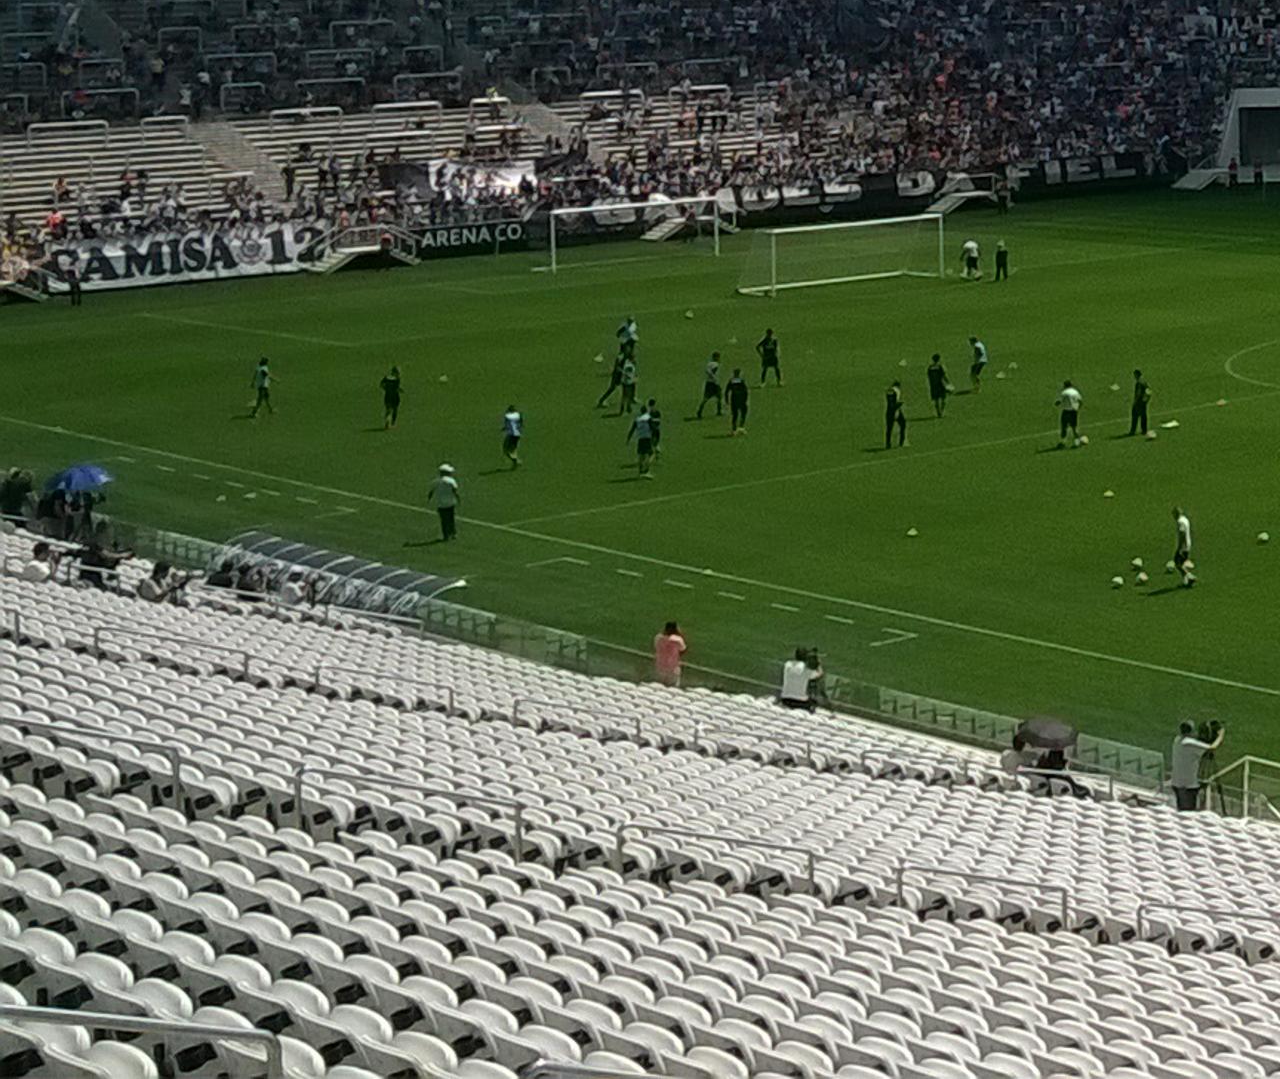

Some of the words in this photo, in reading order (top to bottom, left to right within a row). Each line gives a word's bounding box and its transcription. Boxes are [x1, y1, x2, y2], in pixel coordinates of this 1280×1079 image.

[46, 233, 238, 283] CAMISA
[264, 226, 327, 265] 12
[421, 226, 491, 248] ARENA
